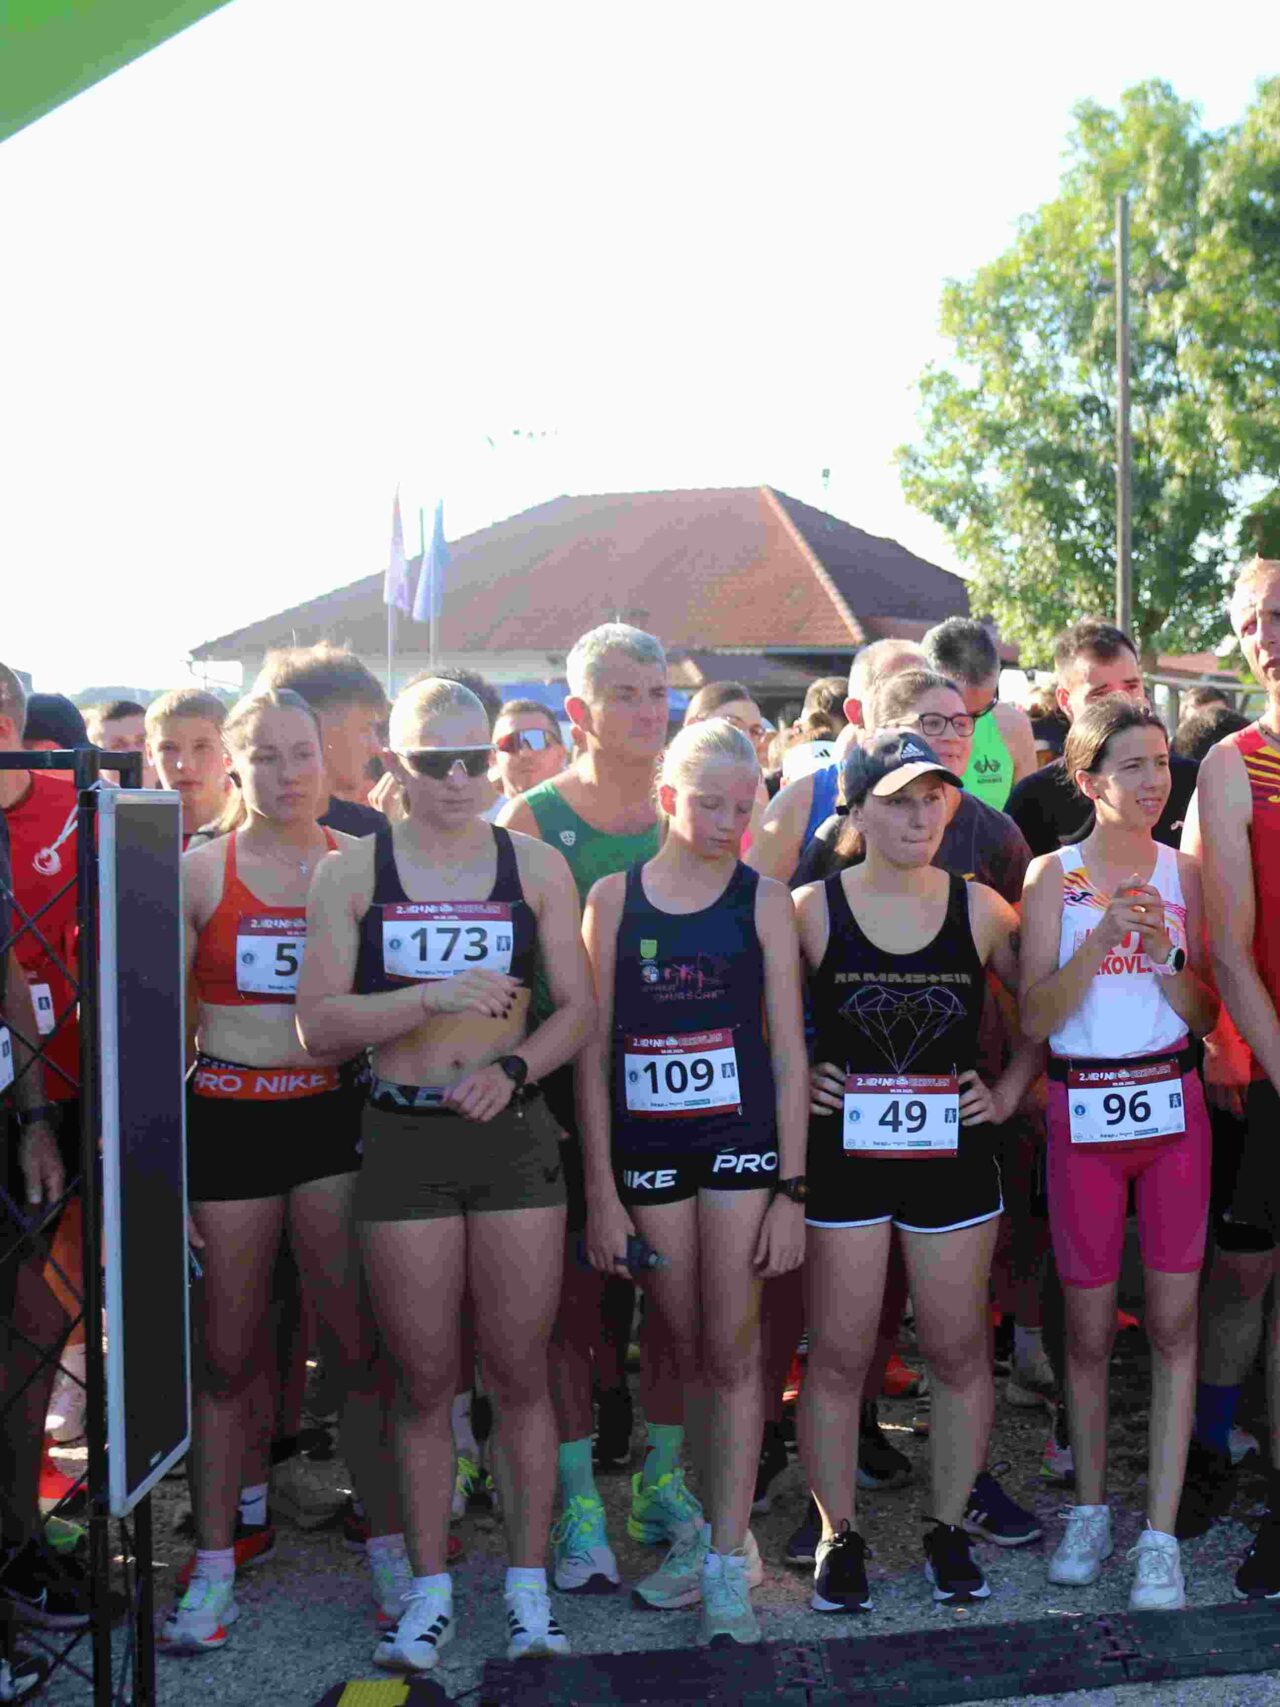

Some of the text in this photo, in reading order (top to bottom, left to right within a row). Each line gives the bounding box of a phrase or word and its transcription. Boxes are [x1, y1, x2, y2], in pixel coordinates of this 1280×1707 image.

[410, 927, 489, 961] 173
[834, 972, 971, 984] RAMMSTEIN
[255, 1074, 328, 1093] NIKE
[643, 1059, 714, 1094] 109
[878, 1100, 927, 1134] 49
[1103, 1090, 1151, 1126] 96
[712, 1151, 778, 1174] PRO
